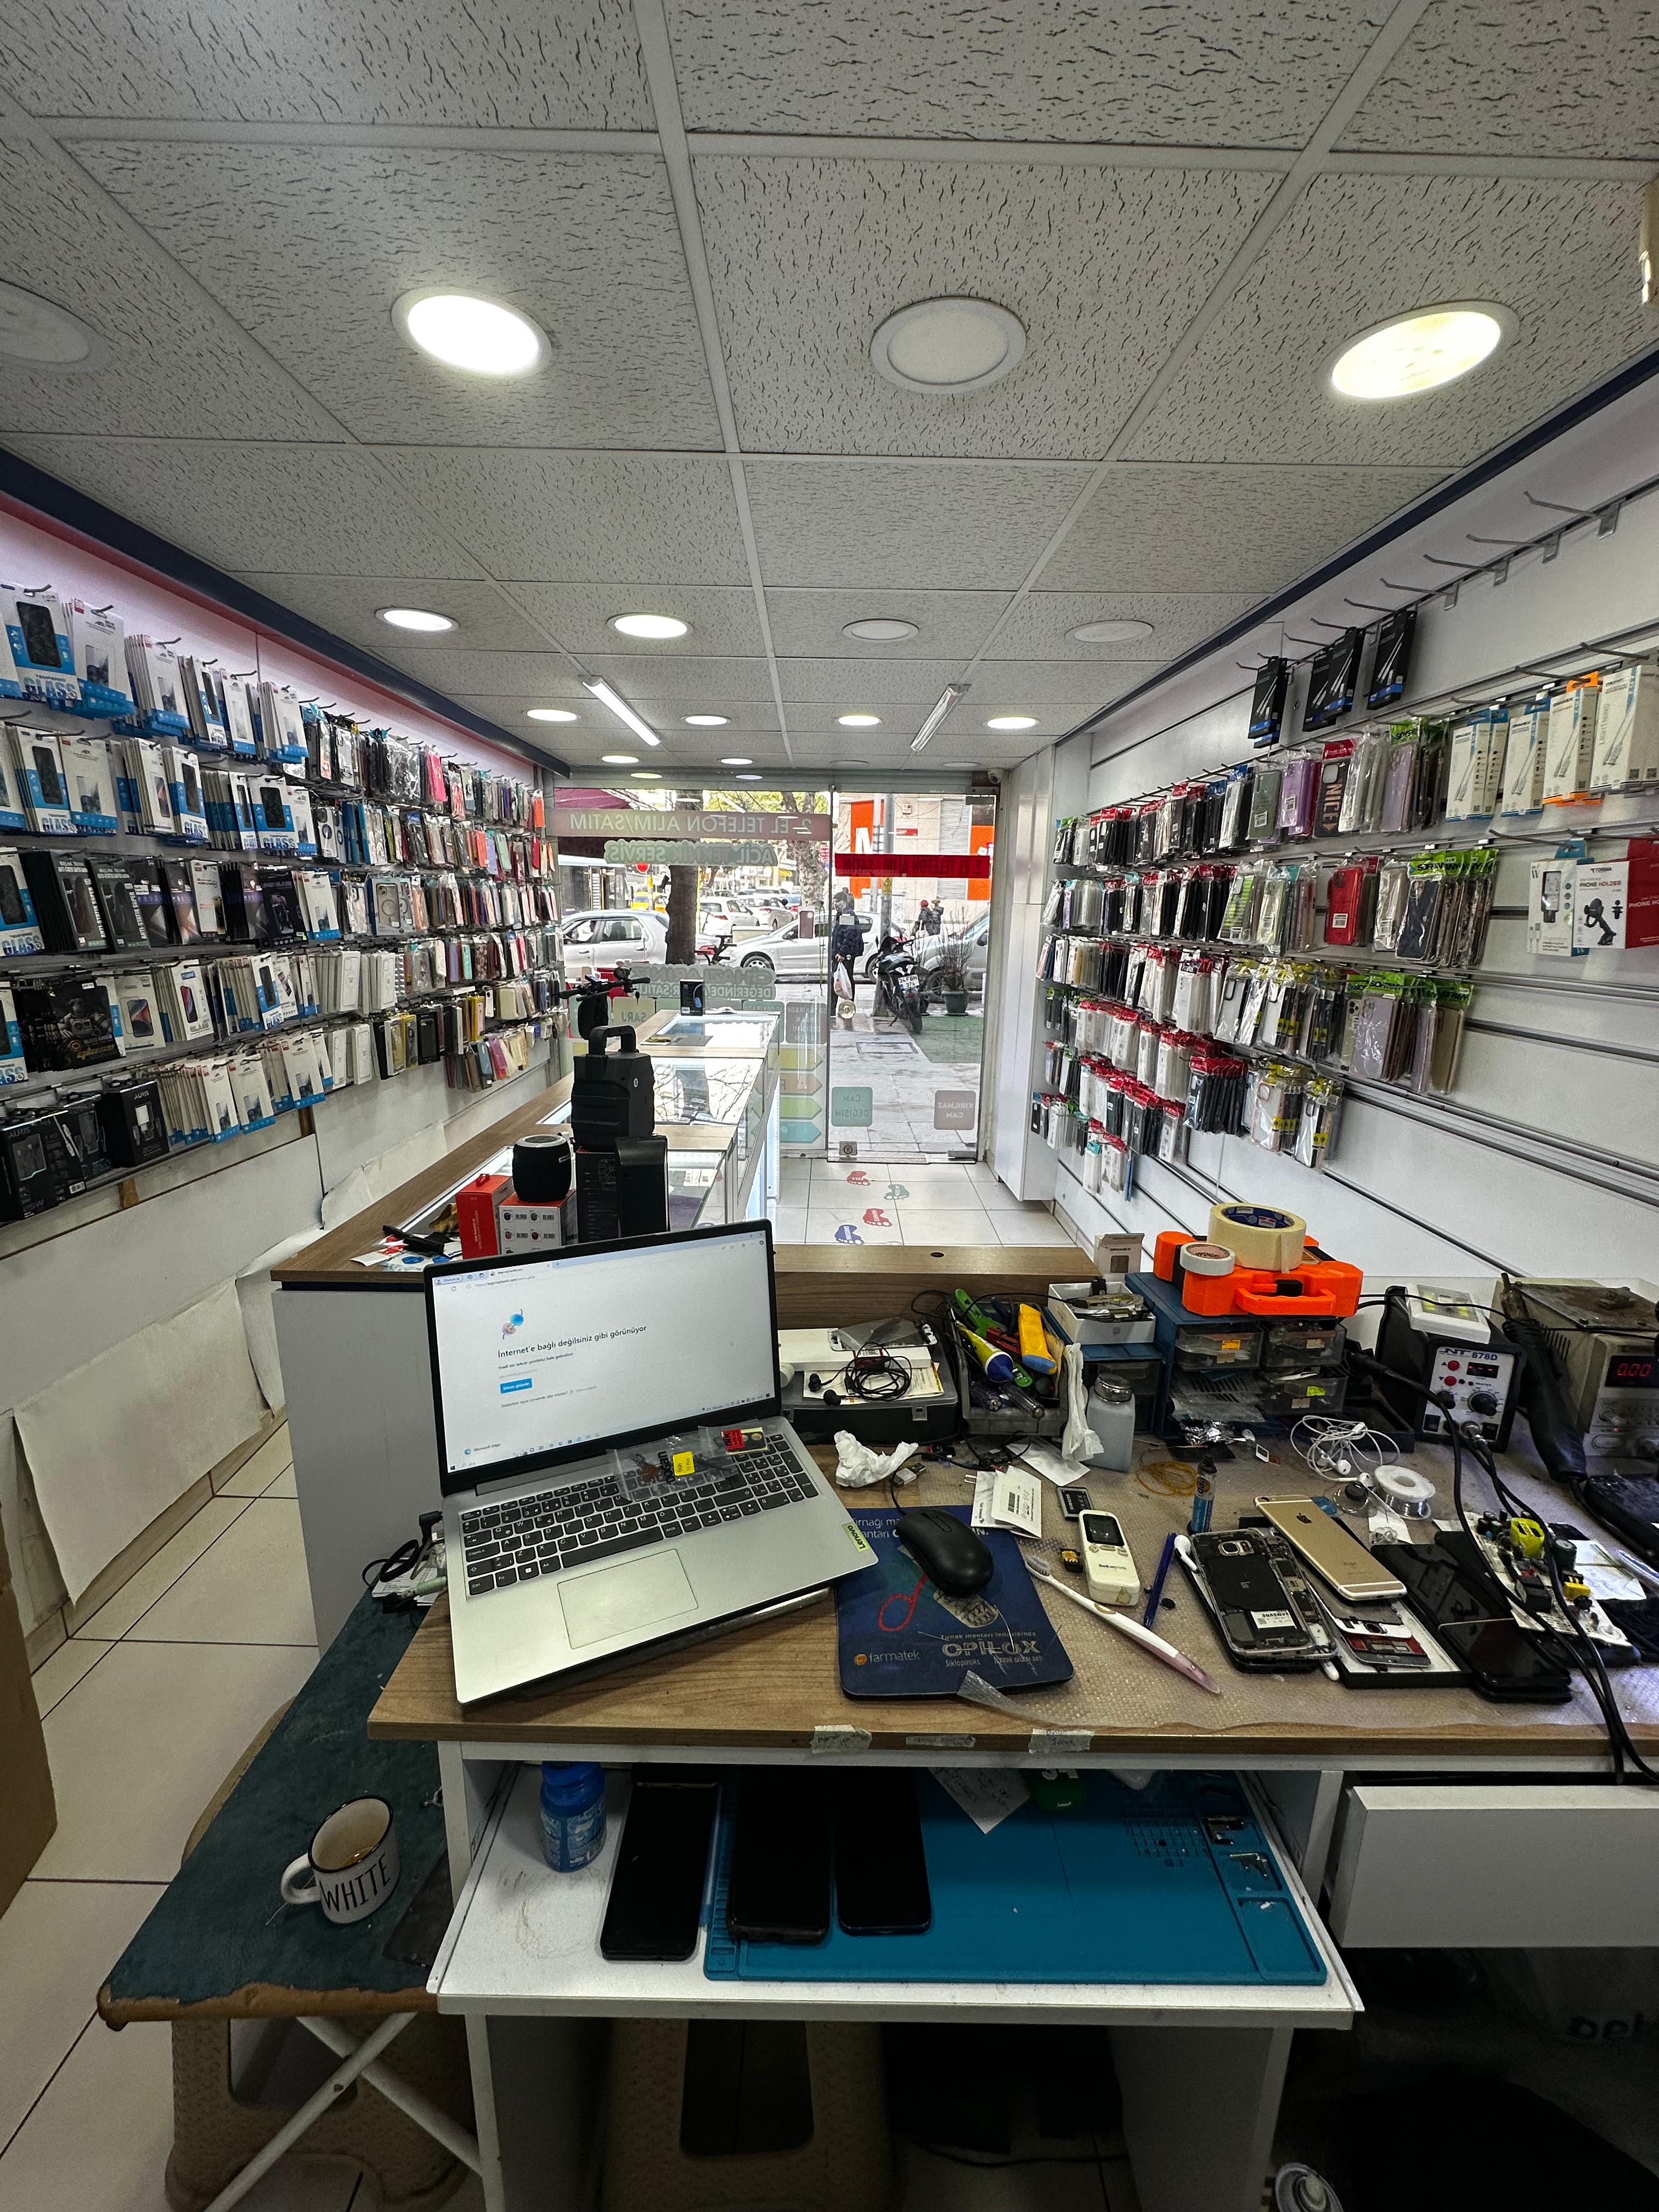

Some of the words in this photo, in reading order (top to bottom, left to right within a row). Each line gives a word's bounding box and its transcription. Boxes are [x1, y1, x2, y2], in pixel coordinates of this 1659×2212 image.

[1323, 783, 1343, 821] NICE
[2, 934, 43, 955] GLASS
[134, 1090, 150, 1099] AURIS
[9, 1126, 31, 1138] AURIS
[498, 1345, 535, 1358] İnternet'e
[538, 1341, 556, 1351] bağlı
[558, 1335, 592, 1346] değilsiniz
[595, 1332, 608, 1342] gibi
[610, 1325, 647, 1339] görünüyor
[1471, 1352, 1498, 1361] 878D
[847, 1525, 866, 1550] Lenovo
[862, 1530, 889, 1538] antarı
[869, 1650, 921, 1663] farmatek
[319, 1852, 391, 1911] WHITE
